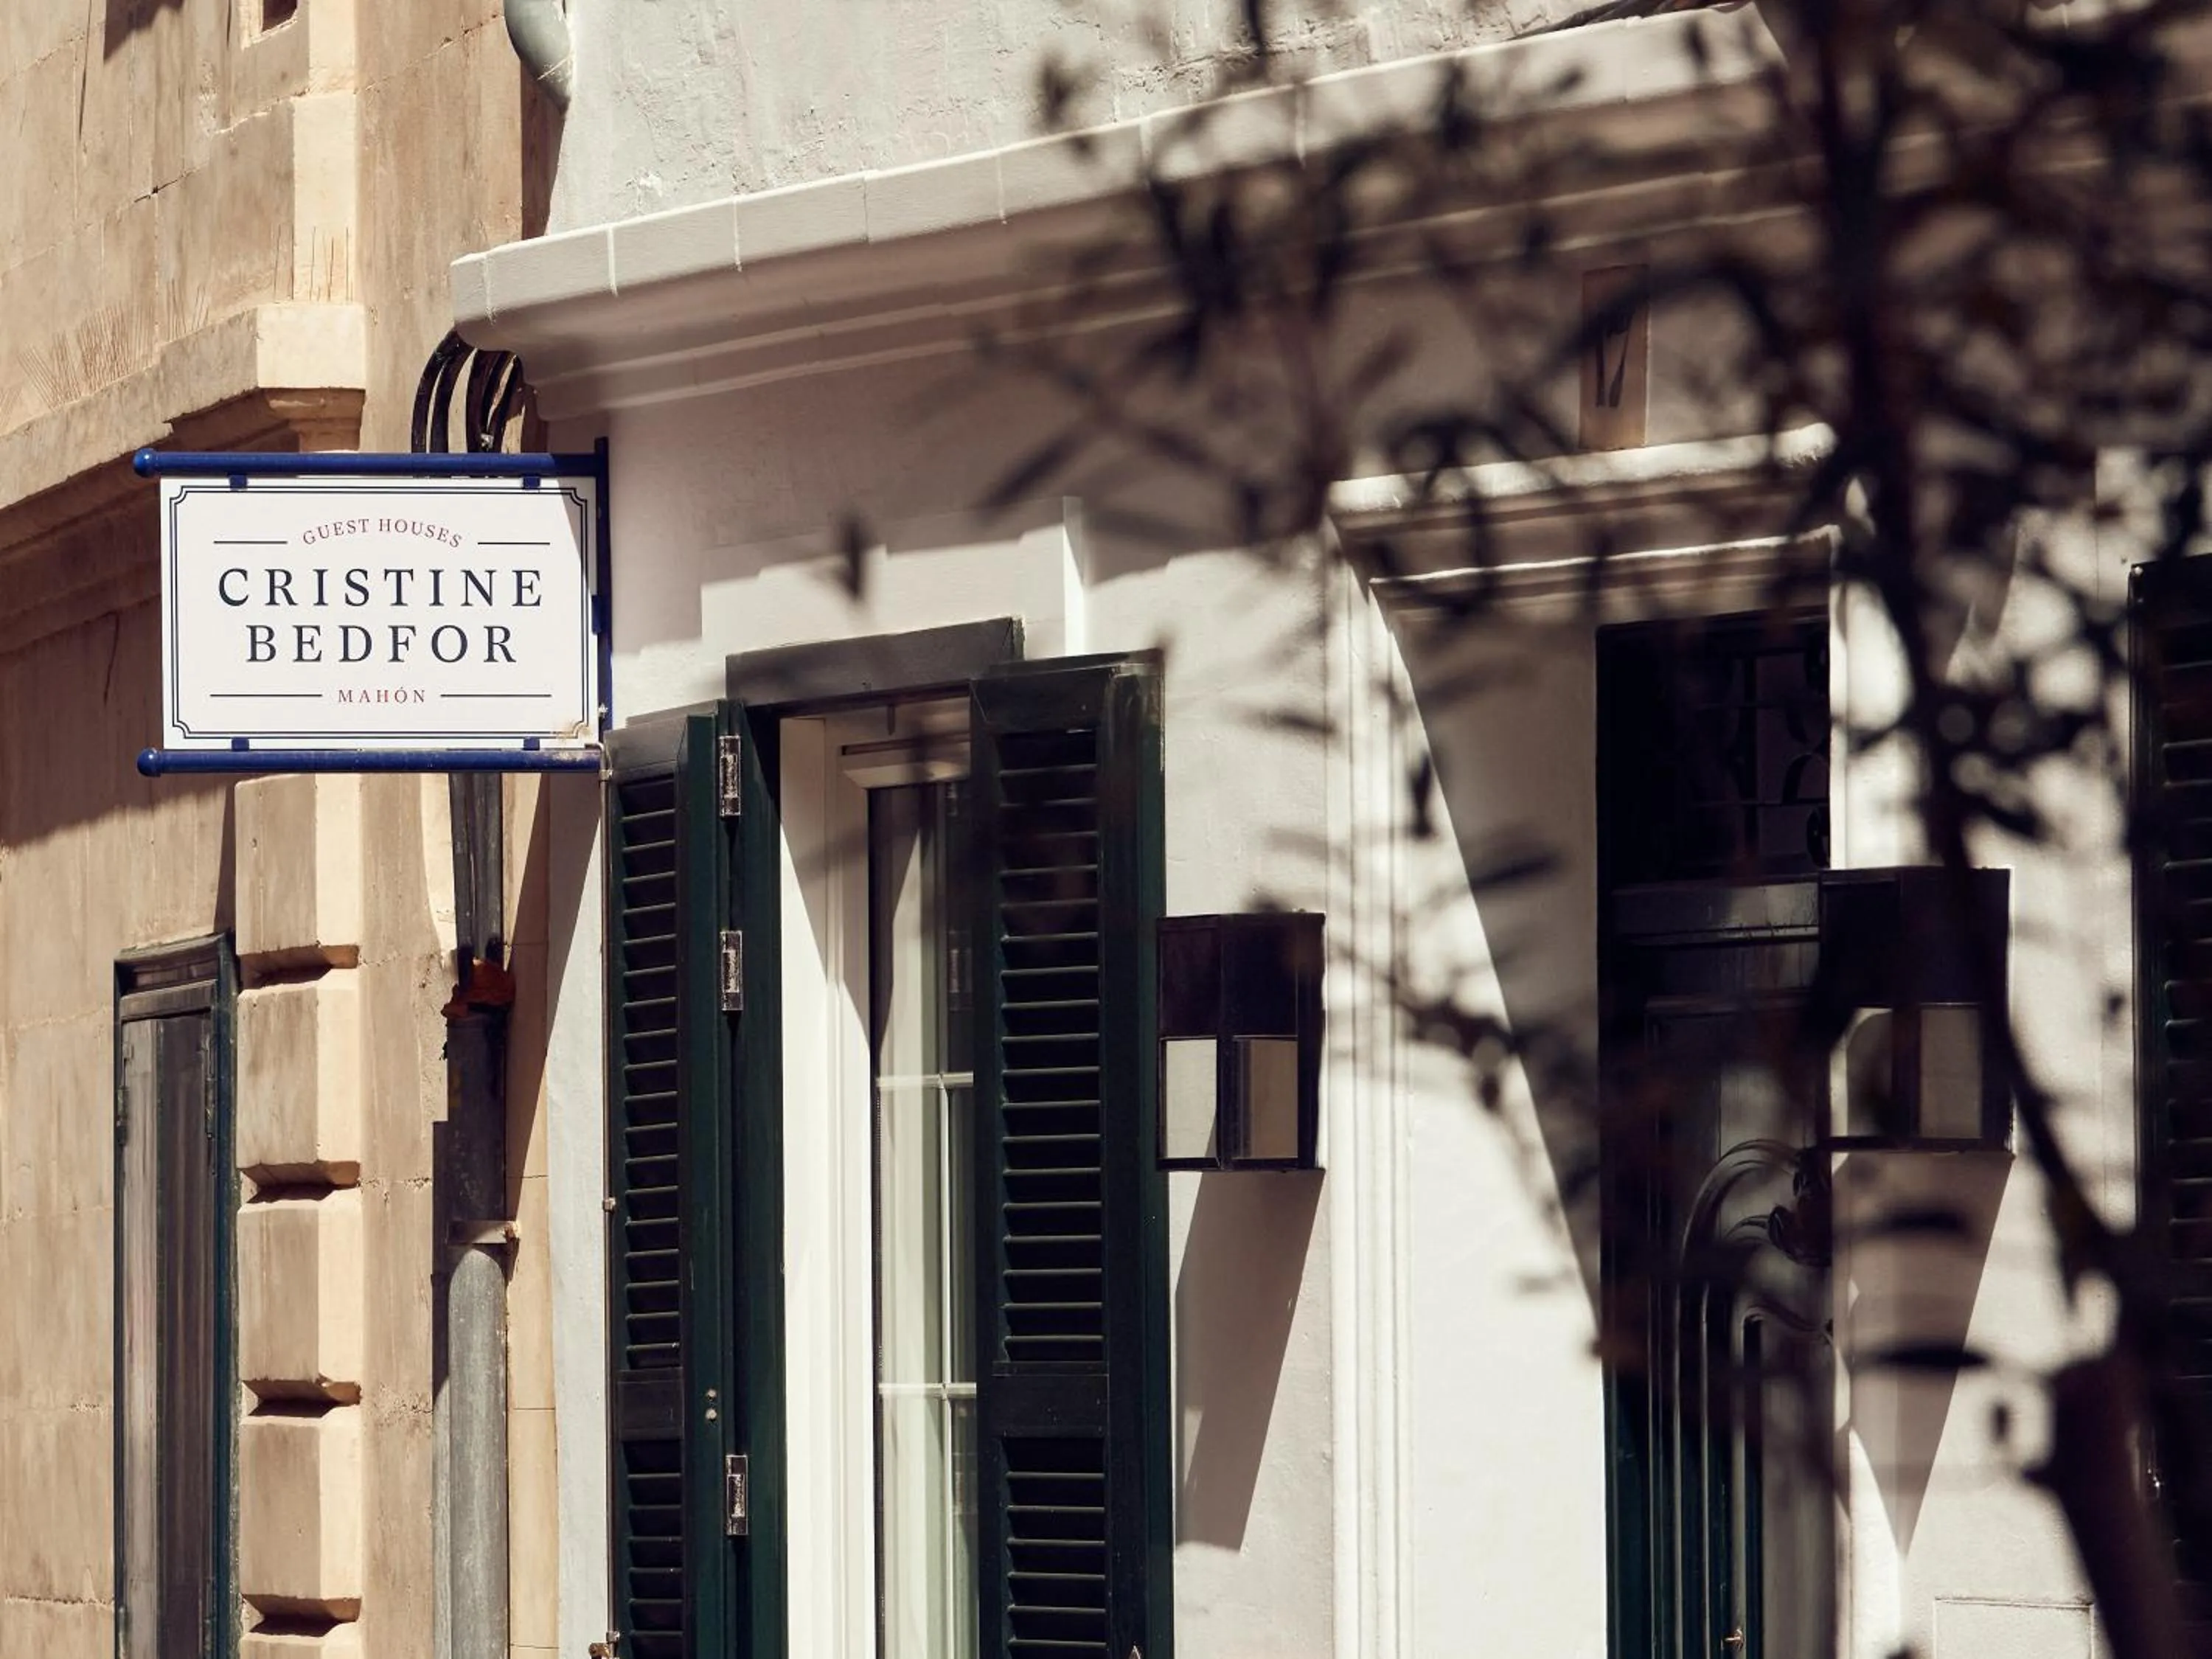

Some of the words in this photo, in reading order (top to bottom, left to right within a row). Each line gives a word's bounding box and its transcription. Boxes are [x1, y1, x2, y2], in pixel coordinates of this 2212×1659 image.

[302, 518, 369, 545] GUEST
[379, 518, 462, 548] HOUSES
[218, 568, 542, 607] CRISTINE
[246, 625, 517, 664] BEDFOR
[338, 686, 425, 703] MAHÓN
